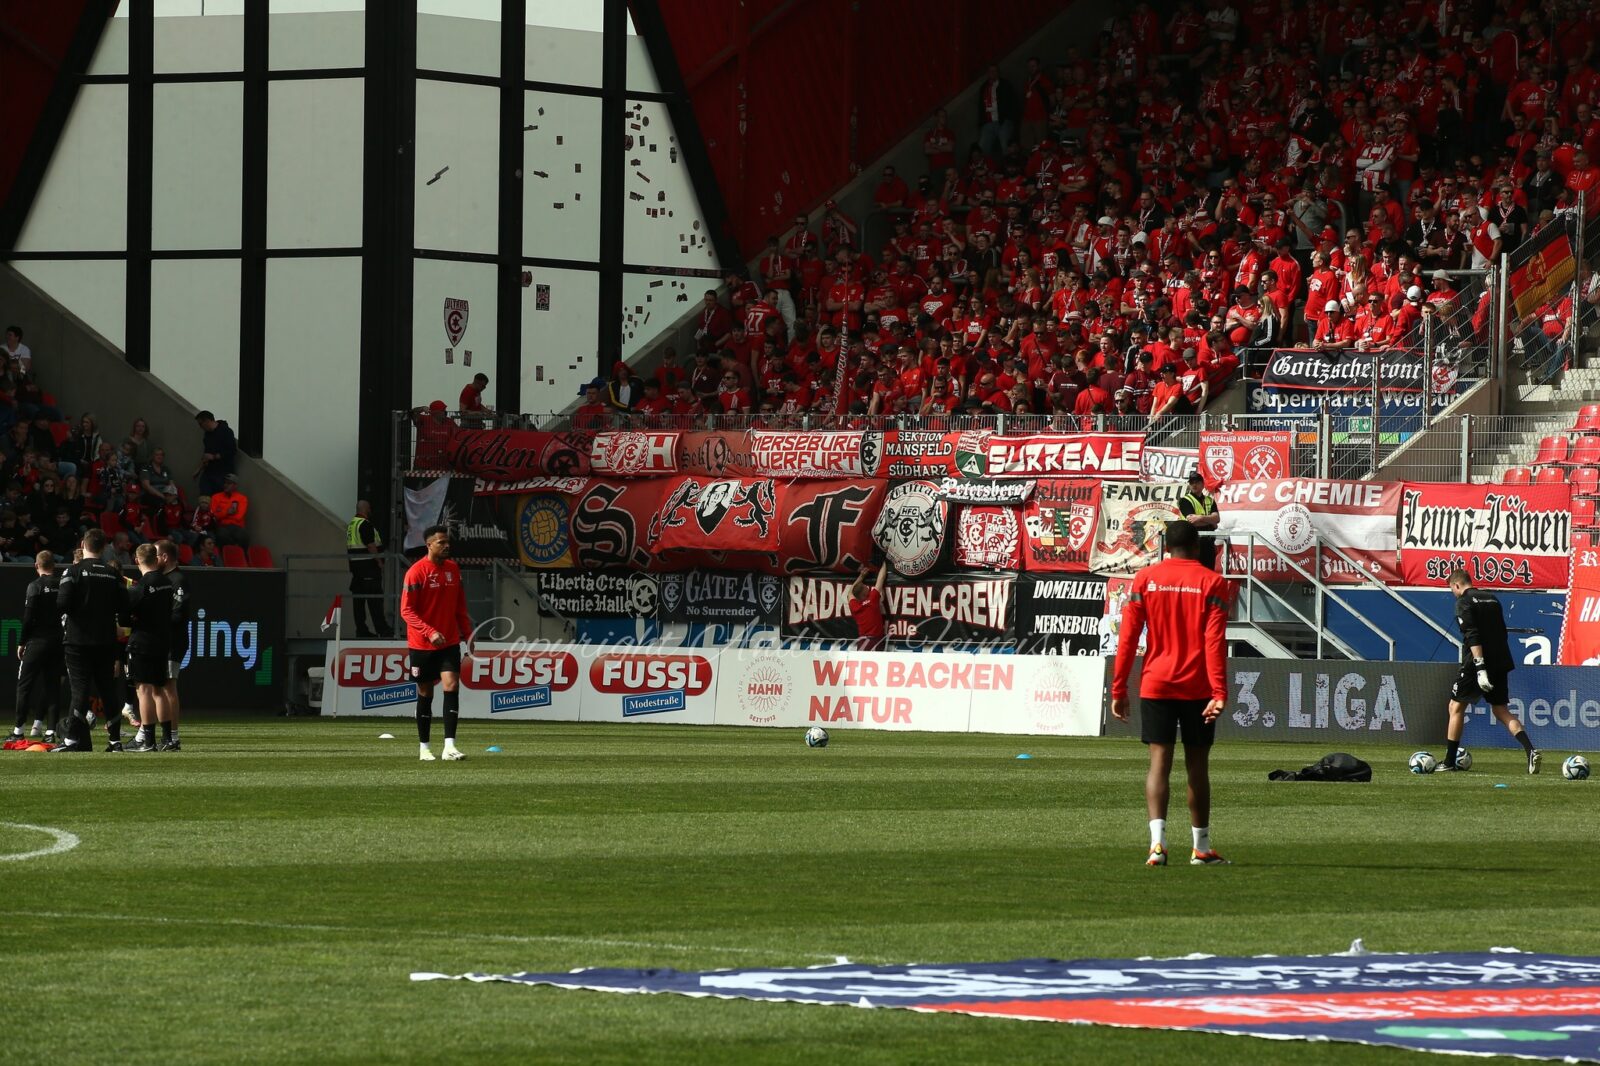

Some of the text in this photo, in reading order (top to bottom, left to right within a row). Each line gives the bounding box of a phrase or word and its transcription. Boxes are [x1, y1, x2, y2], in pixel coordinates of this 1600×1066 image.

[747, 312, 764, 331] 27
[898, 431, 943, 442] SEKTION
[1237, 435, 1264, 443] KNAPPEN
[1272, 435, 1288, 443] TOUR
[885, 441, 952, 456] MANSFELD
[1211, 448, 1228, 456] HFC
[989, 441, 1140, 473] SURREALE
[889, 461, 948, 477] SÜDHARZ
[1218, 481, 1384, 507] HFC CHEMIE
[901, 508, 918, 516] HFC
[1071, 506, 1089, 516] HFC
[991, 515, 1003, 524] FC
[1106, 518, 1119, 531] 19
[1403, 489, 1570, 553] Leuna-Löwen
[1472, 556, 1533, 584] 1984
[665, 574, 681, 582] HFC
[686, 569, 757, 604] GATE A
[686, 605, 757, 617] No Surrender
[885, 620, 918, 636] alle
[745, 655, 785, 671] HANDWERK
[471, 657, 569, 685] FUSSL
[602, 660, 703, 689] FUSSL
[813, 660, 879, 687] WIR
[886, 660, 1014, 691] BACKEN
[367, 687, 415, 703] Modestraße
[747, 683, 783, 696] HAHN
[1034, 690, 1071, 703] HAHN
[497, 691, 546, 706] Modestraße
[629, 695, 679, 710] Modestraße
[1232, 671, 1407, 731] 3. LIGA
[808, 696, 913, 724] NATUR
[749, 713, 762, 723] SEIT
